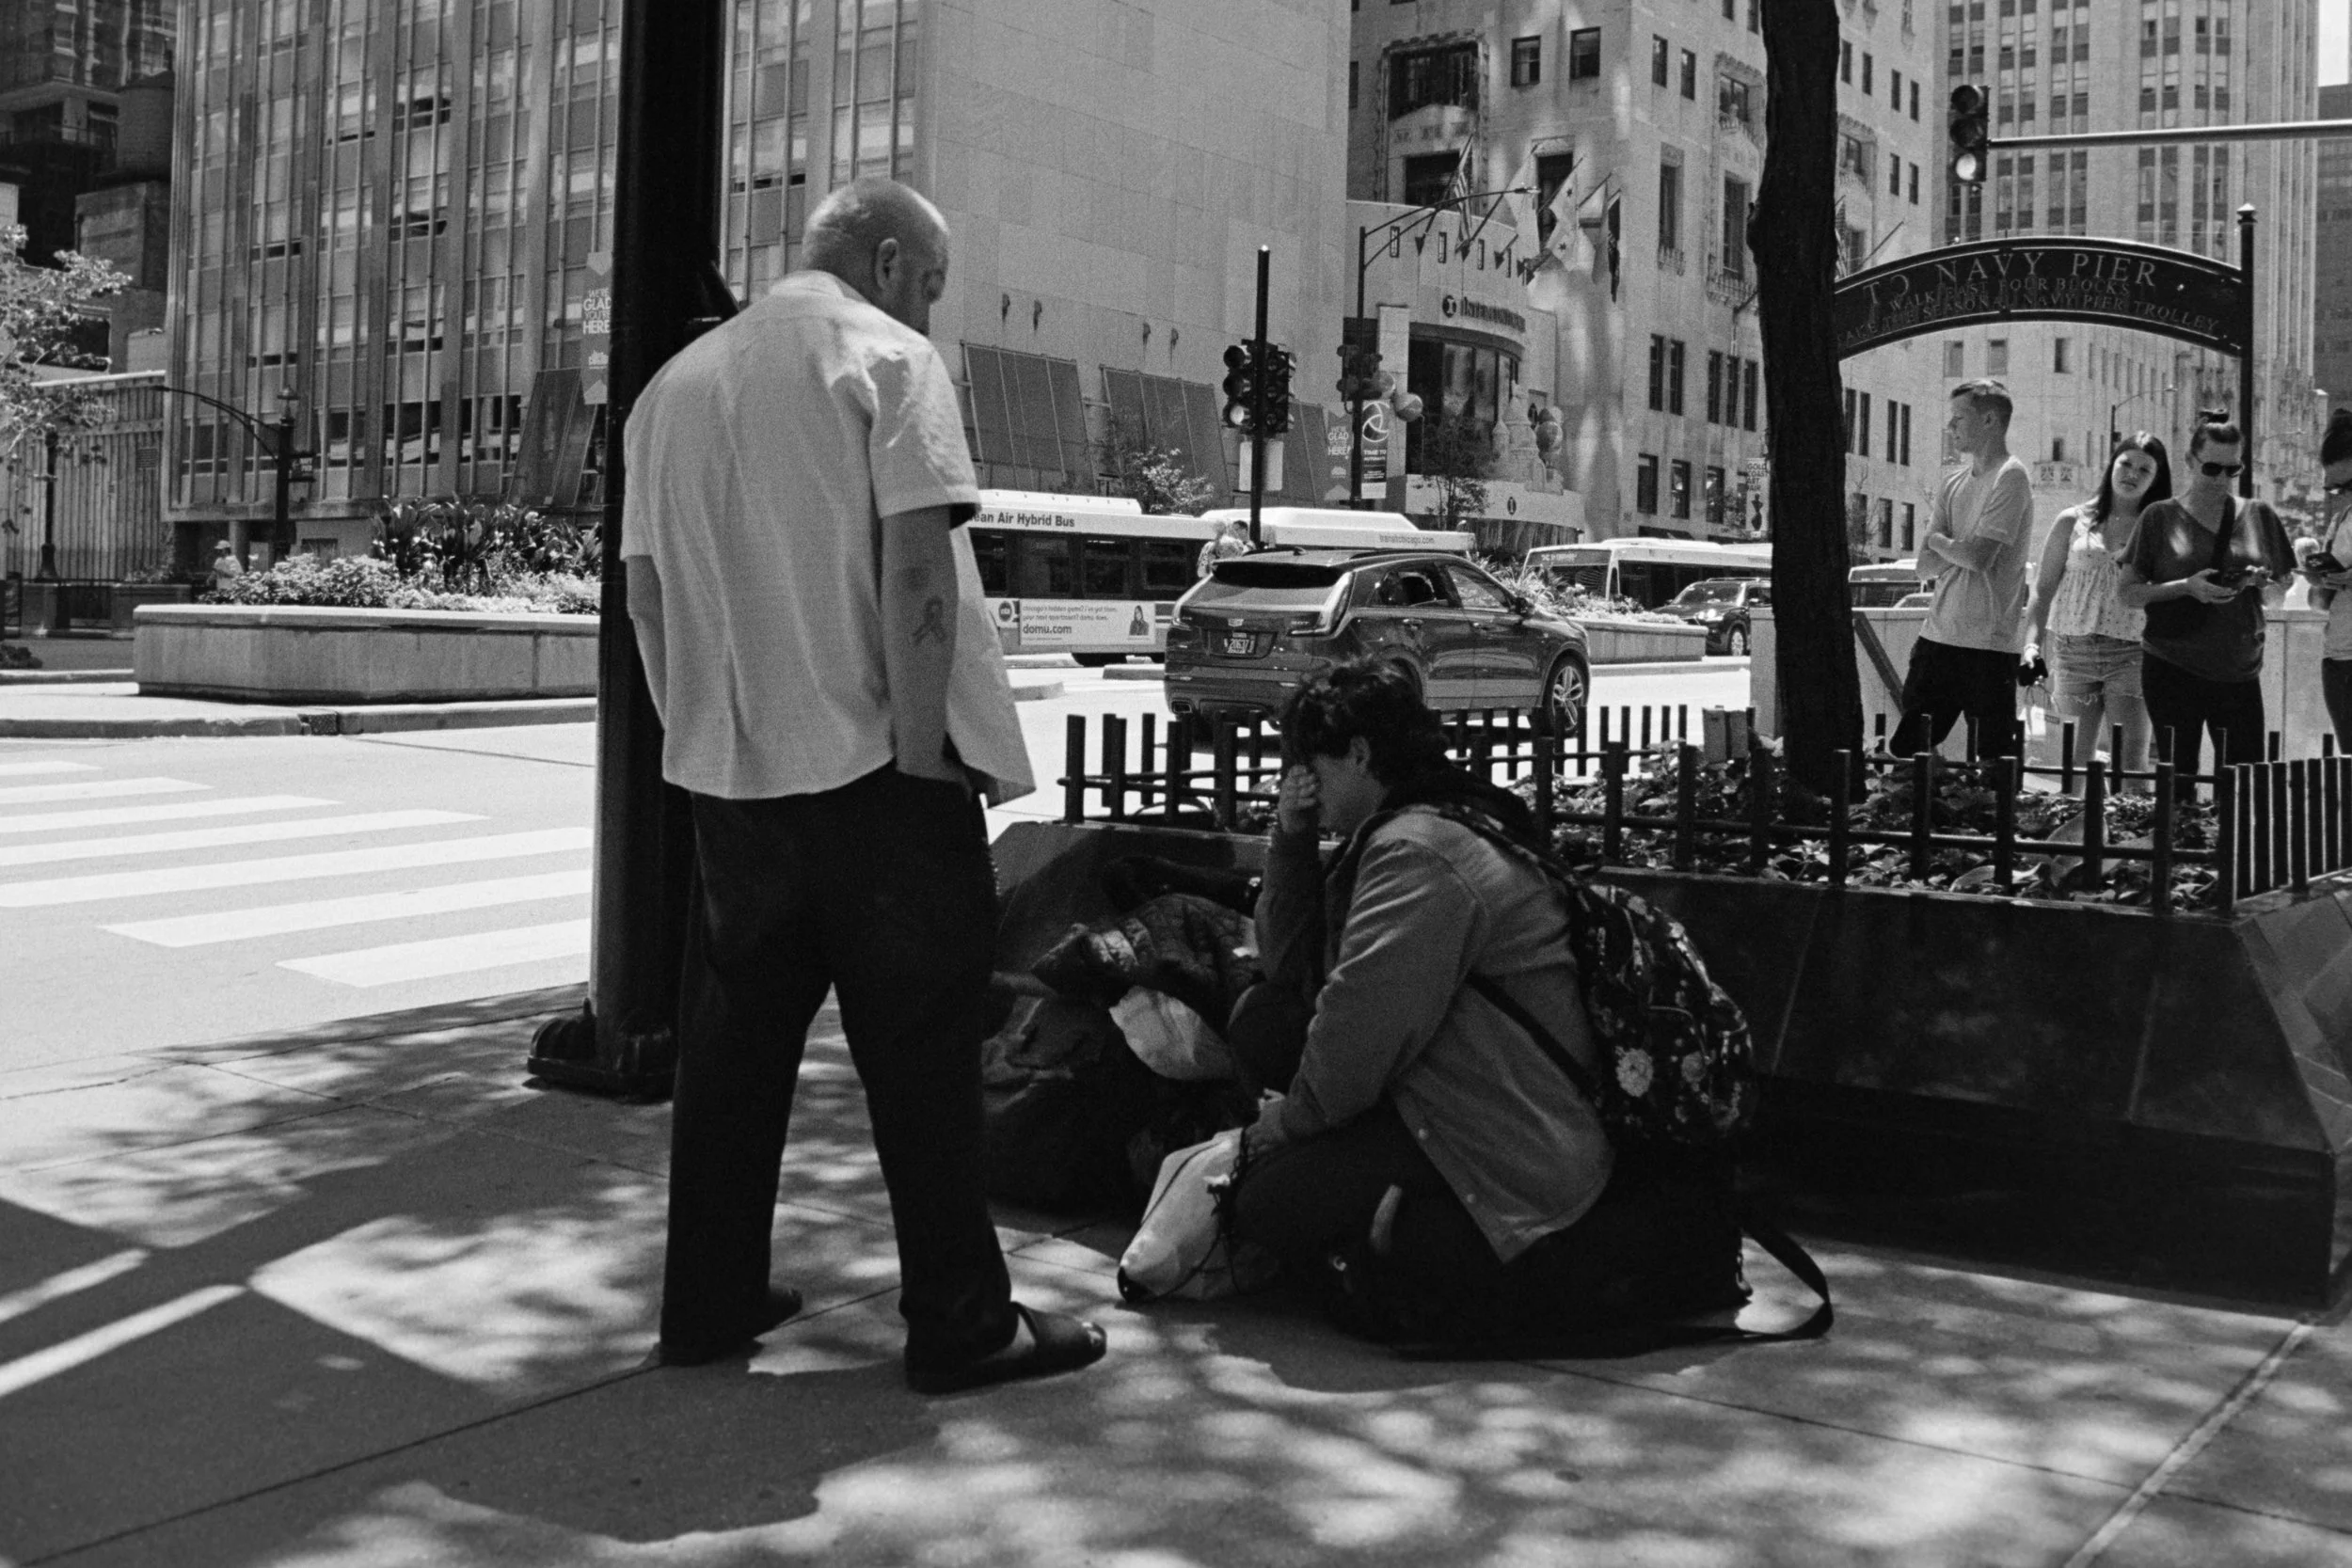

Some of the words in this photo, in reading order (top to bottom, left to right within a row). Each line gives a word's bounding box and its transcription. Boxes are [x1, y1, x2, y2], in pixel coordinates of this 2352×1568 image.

[1935, 251, 2045, 282] NAVY
[2071, 252, 2155, 286] PIER
[1889, 291, 1935, 311] WALK
[1998, 278, 2048, 292] FOUR
[2056, 277, 2131, 295] BLOCKS
[583, 296, 612, 310] GLAD
[2023, 293, 2074, 308] NAVY
[2083, 293, 2124, 311] PIER
[2133, 300, 2219, 332] TROLLEY
[1327, 432, 1349, 440] GLAD
[997, 511, 1013, 524] Air
[1017, 513, 1052, 527] Hybrid
[1055, 515, 1074, 528] Bus
[1023, 623, 1073, 634] domu.com
